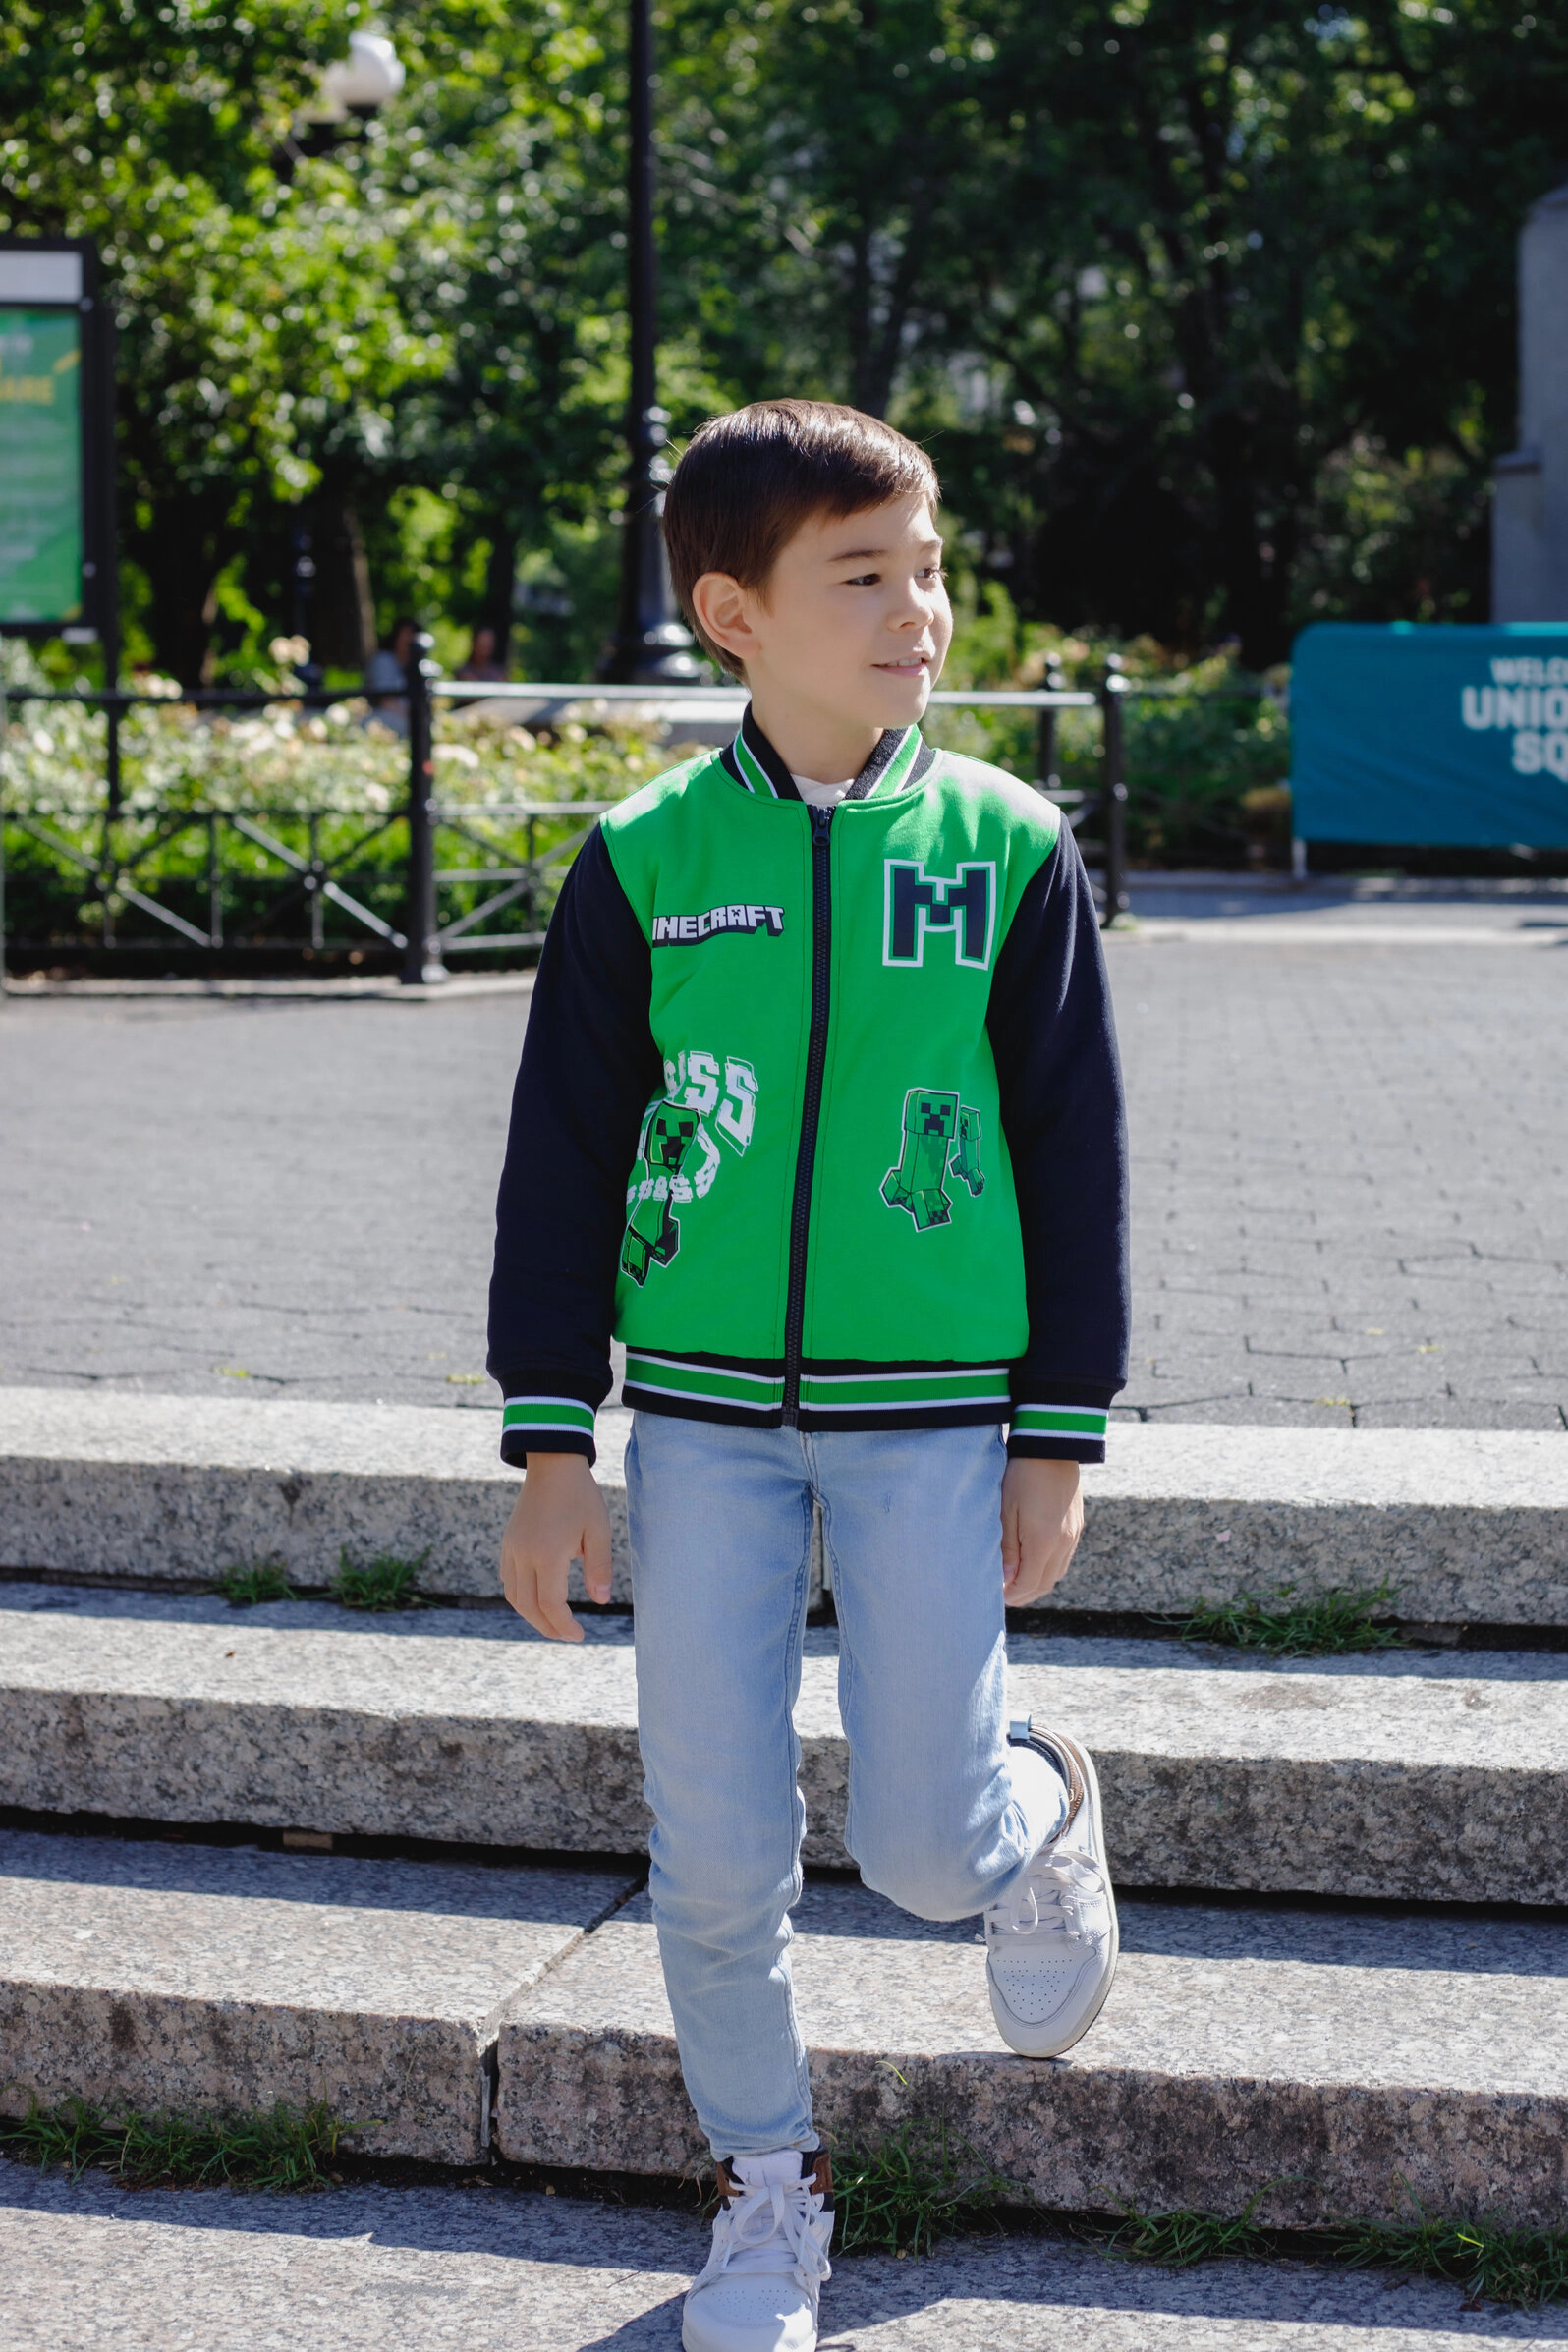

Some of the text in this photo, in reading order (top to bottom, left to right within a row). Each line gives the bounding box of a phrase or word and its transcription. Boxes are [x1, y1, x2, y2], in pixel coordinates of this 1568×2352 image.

[1462, 686, 1568, 729] UNIO
[1512, 732, 1568, 783] SQ
[882, 858, 996, 971] M
